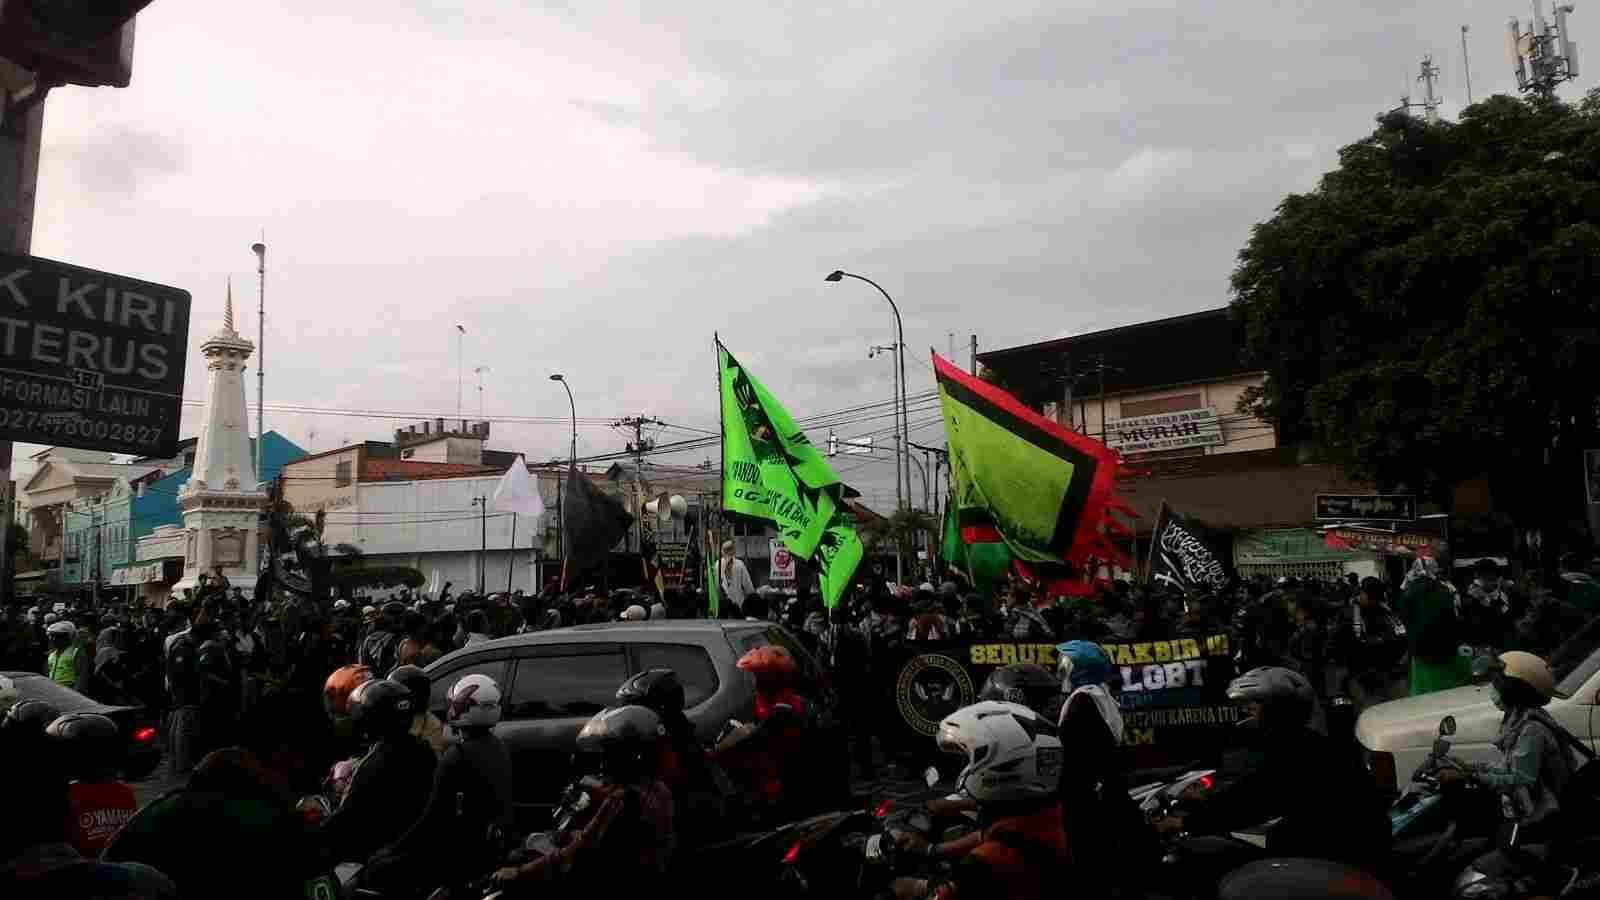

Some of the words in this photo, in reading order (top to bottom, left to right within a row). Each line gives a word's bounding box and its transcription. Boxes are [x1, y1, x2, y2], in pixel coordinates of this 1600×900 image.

[56, 276, 176, 336] KIRI
[0, 318, 168, 380] TERUS
[970, 643, 1057, 664] SERUK
[1119, 659, 1207, 693] LGBT
